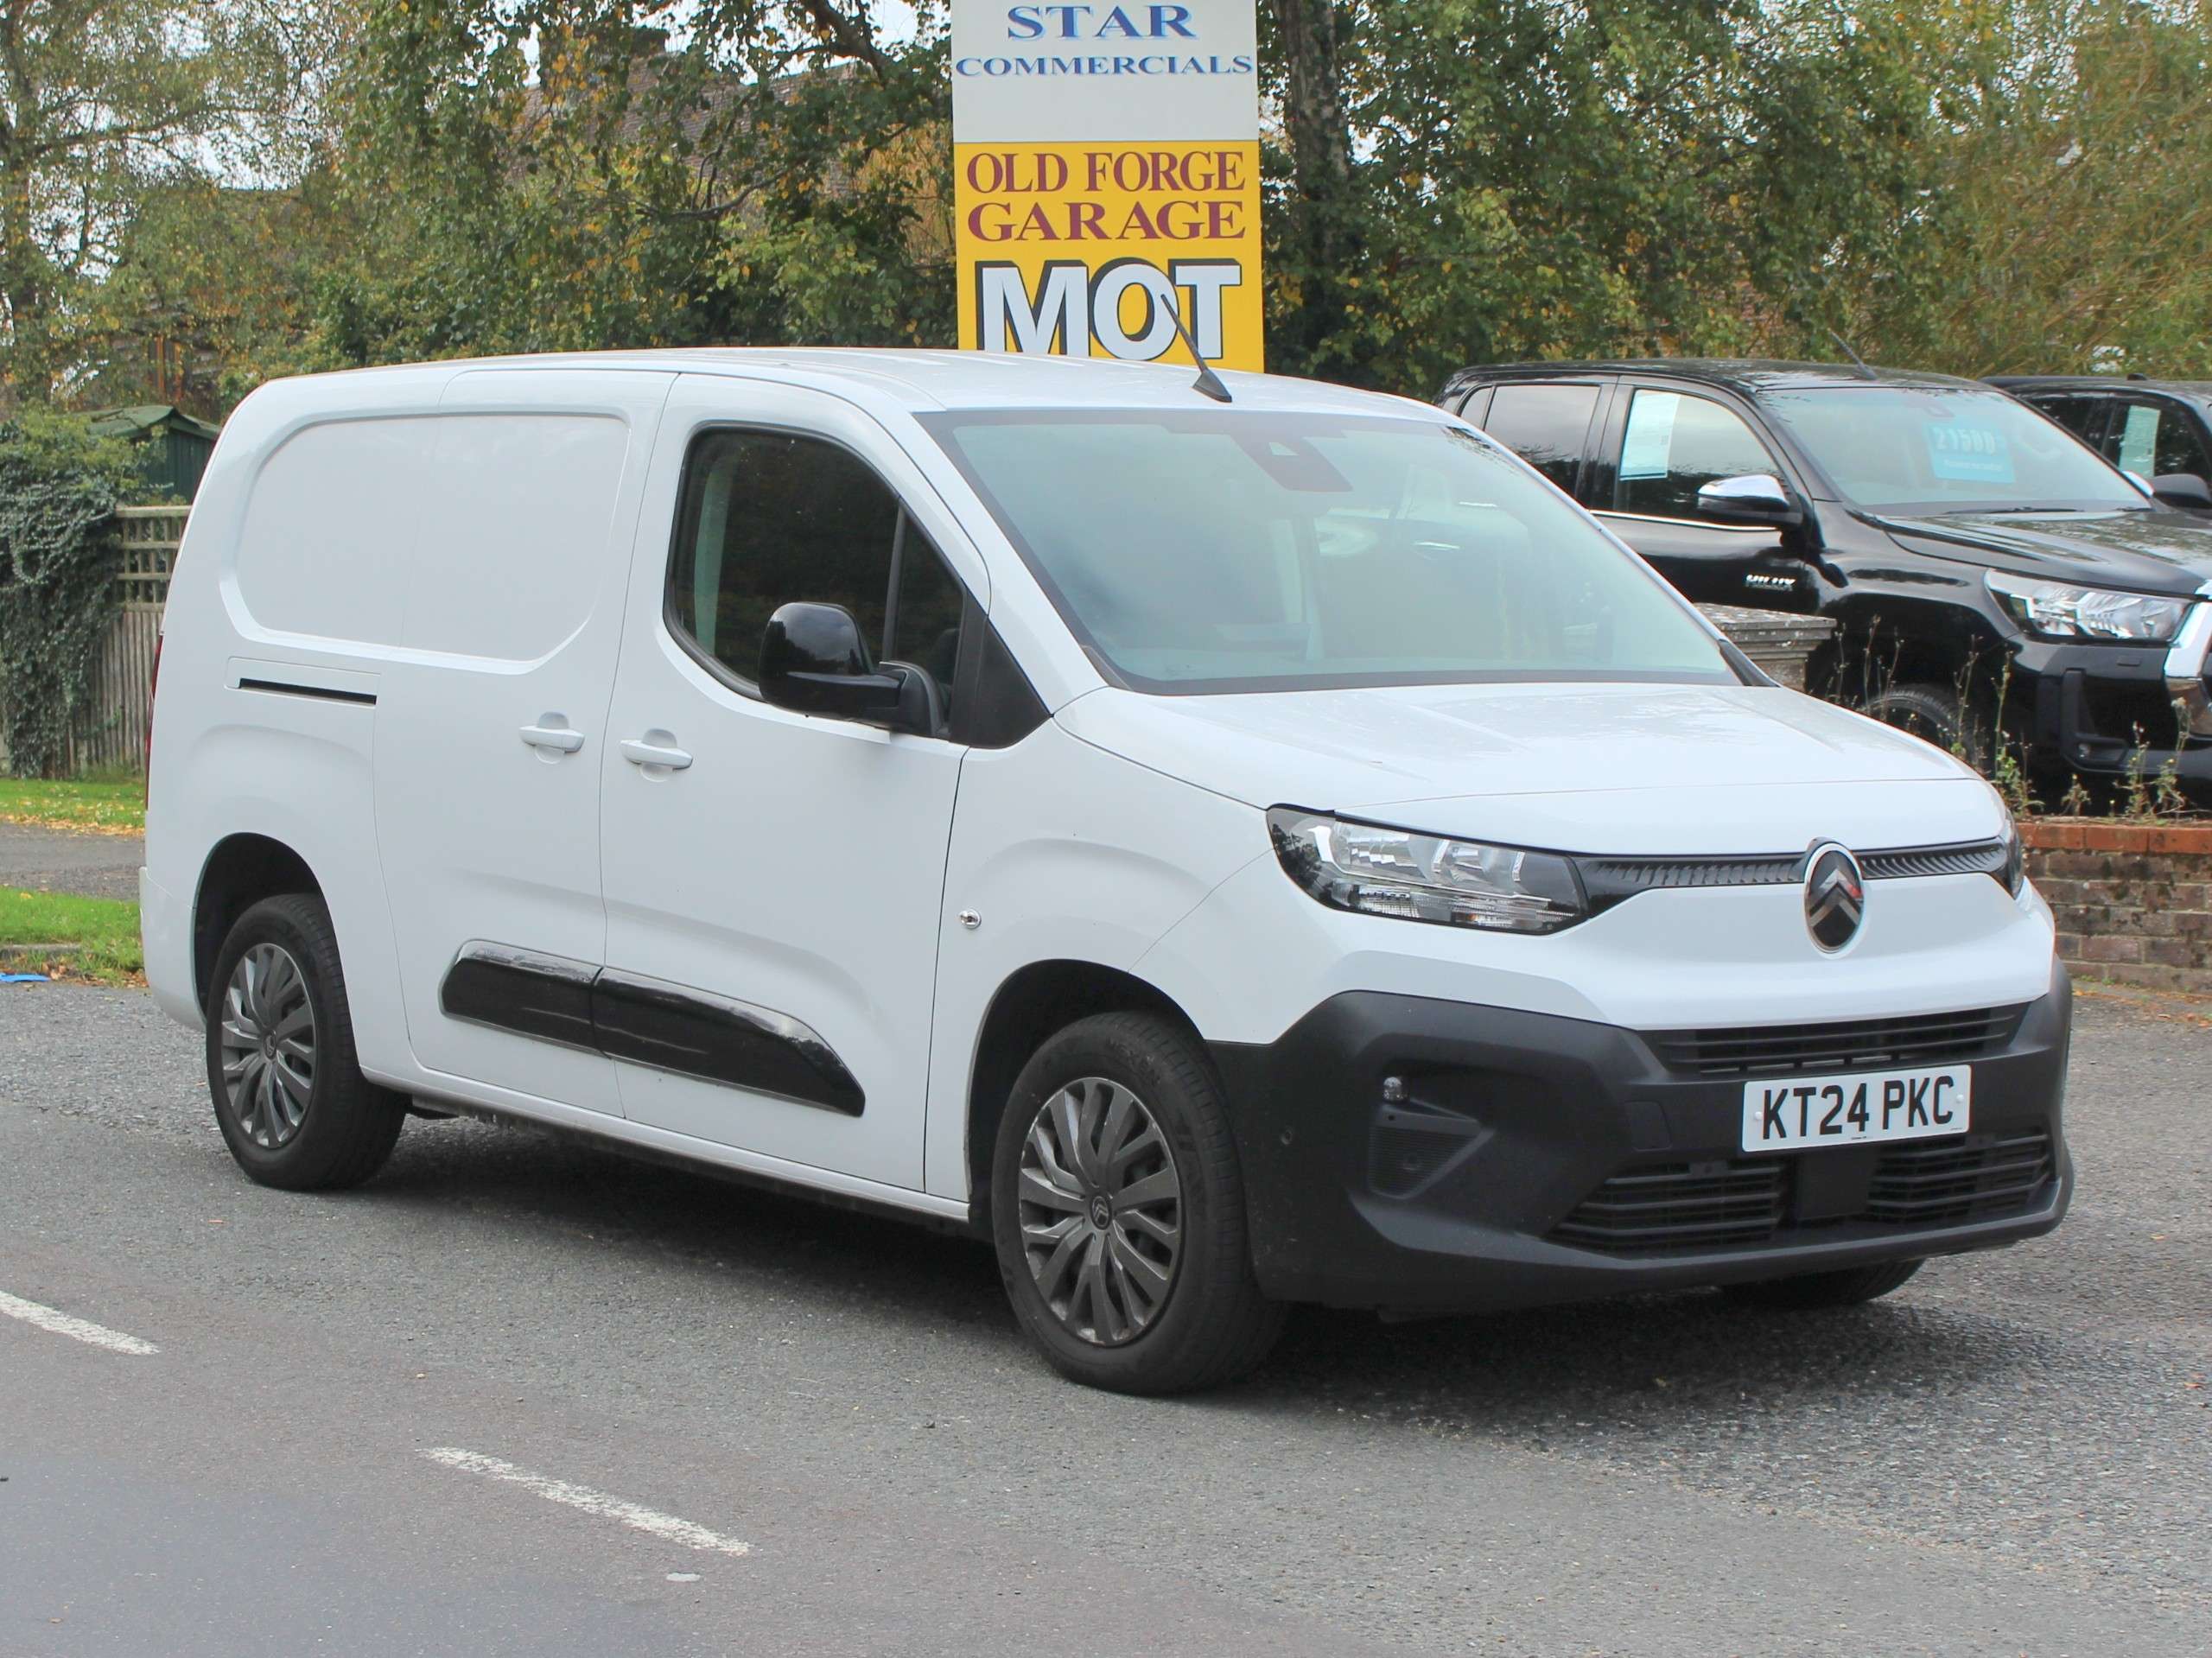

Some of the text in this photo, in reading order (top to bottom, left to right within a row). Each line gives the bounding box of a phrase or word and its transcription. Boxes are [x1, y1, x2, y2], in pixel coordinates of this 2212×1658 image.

[1007, 4, 1197, 40] STAR
[956, 54, 1253, 77] COMMERCIALS
[967, 150, 1247, 194] OLD FORGE
[967, 200, 1247, 242] GARAGE
[975, 257, 1243, 361] MOT
[1763, 1075, 1955, 1140] KT24 PKC
